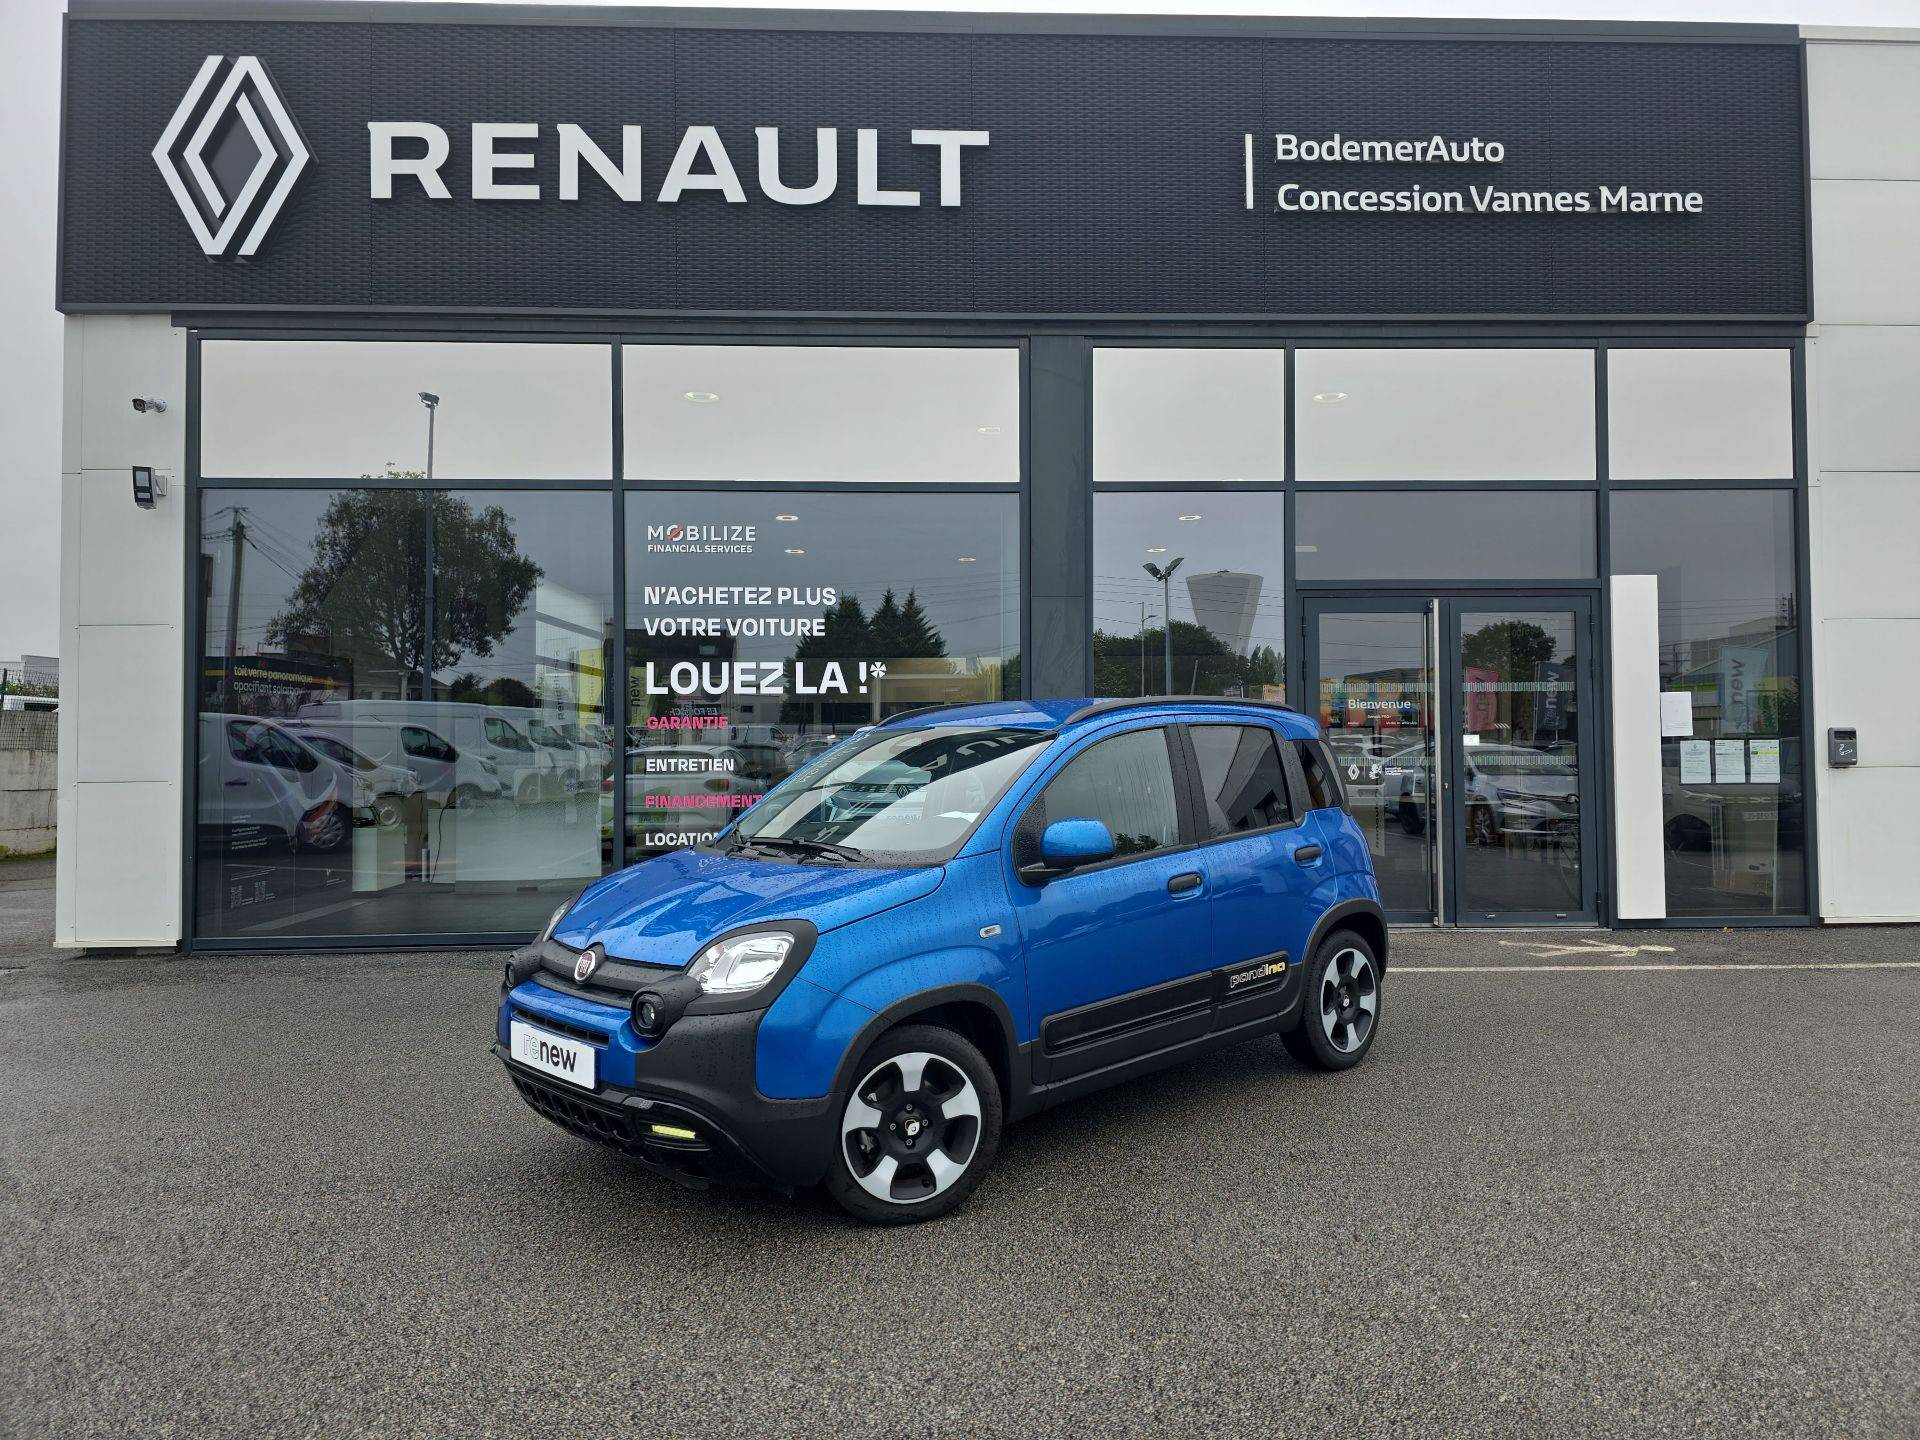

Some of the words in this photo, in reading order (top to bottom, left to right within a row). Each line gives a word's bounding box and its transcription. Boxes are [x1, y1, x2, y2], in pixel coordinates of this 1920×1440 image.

[1275, 133, 1505, 162] BodemerAuto
[368, 121, 990, 207] RENAULT
[1277, 183, 1465, 212] Concession
[1469, 185, 1591, 213] Vannes
[1599, 186, 1703, 213] Marne
[647, 524, 756, 542] MOBILIZE
[647, 544, 702, 553] FINANCIAL
[704, 545, 753, 553] SERVICES
[644, 586, 772, 605] N'ACHETEZ
[777, 587, 837, 606] PLUS
[644, 617, 721, 636] VOTRE
[726, 618, 826, 636] VOITURE
[646, 661, 784, 695] LOUEZ
[795, 661, 848, 694] LA
[1348, 698, 1411, 709] Bienvenue
[647, 716, 729, 730] GARANTIE
[646, 758, 735, 772] ENTRETIEN
[645, 794, 763, 808] FINANCEMENT
[1230, 961, 1286, 988] pandina
[523, 1033, 577, 1073] renew
